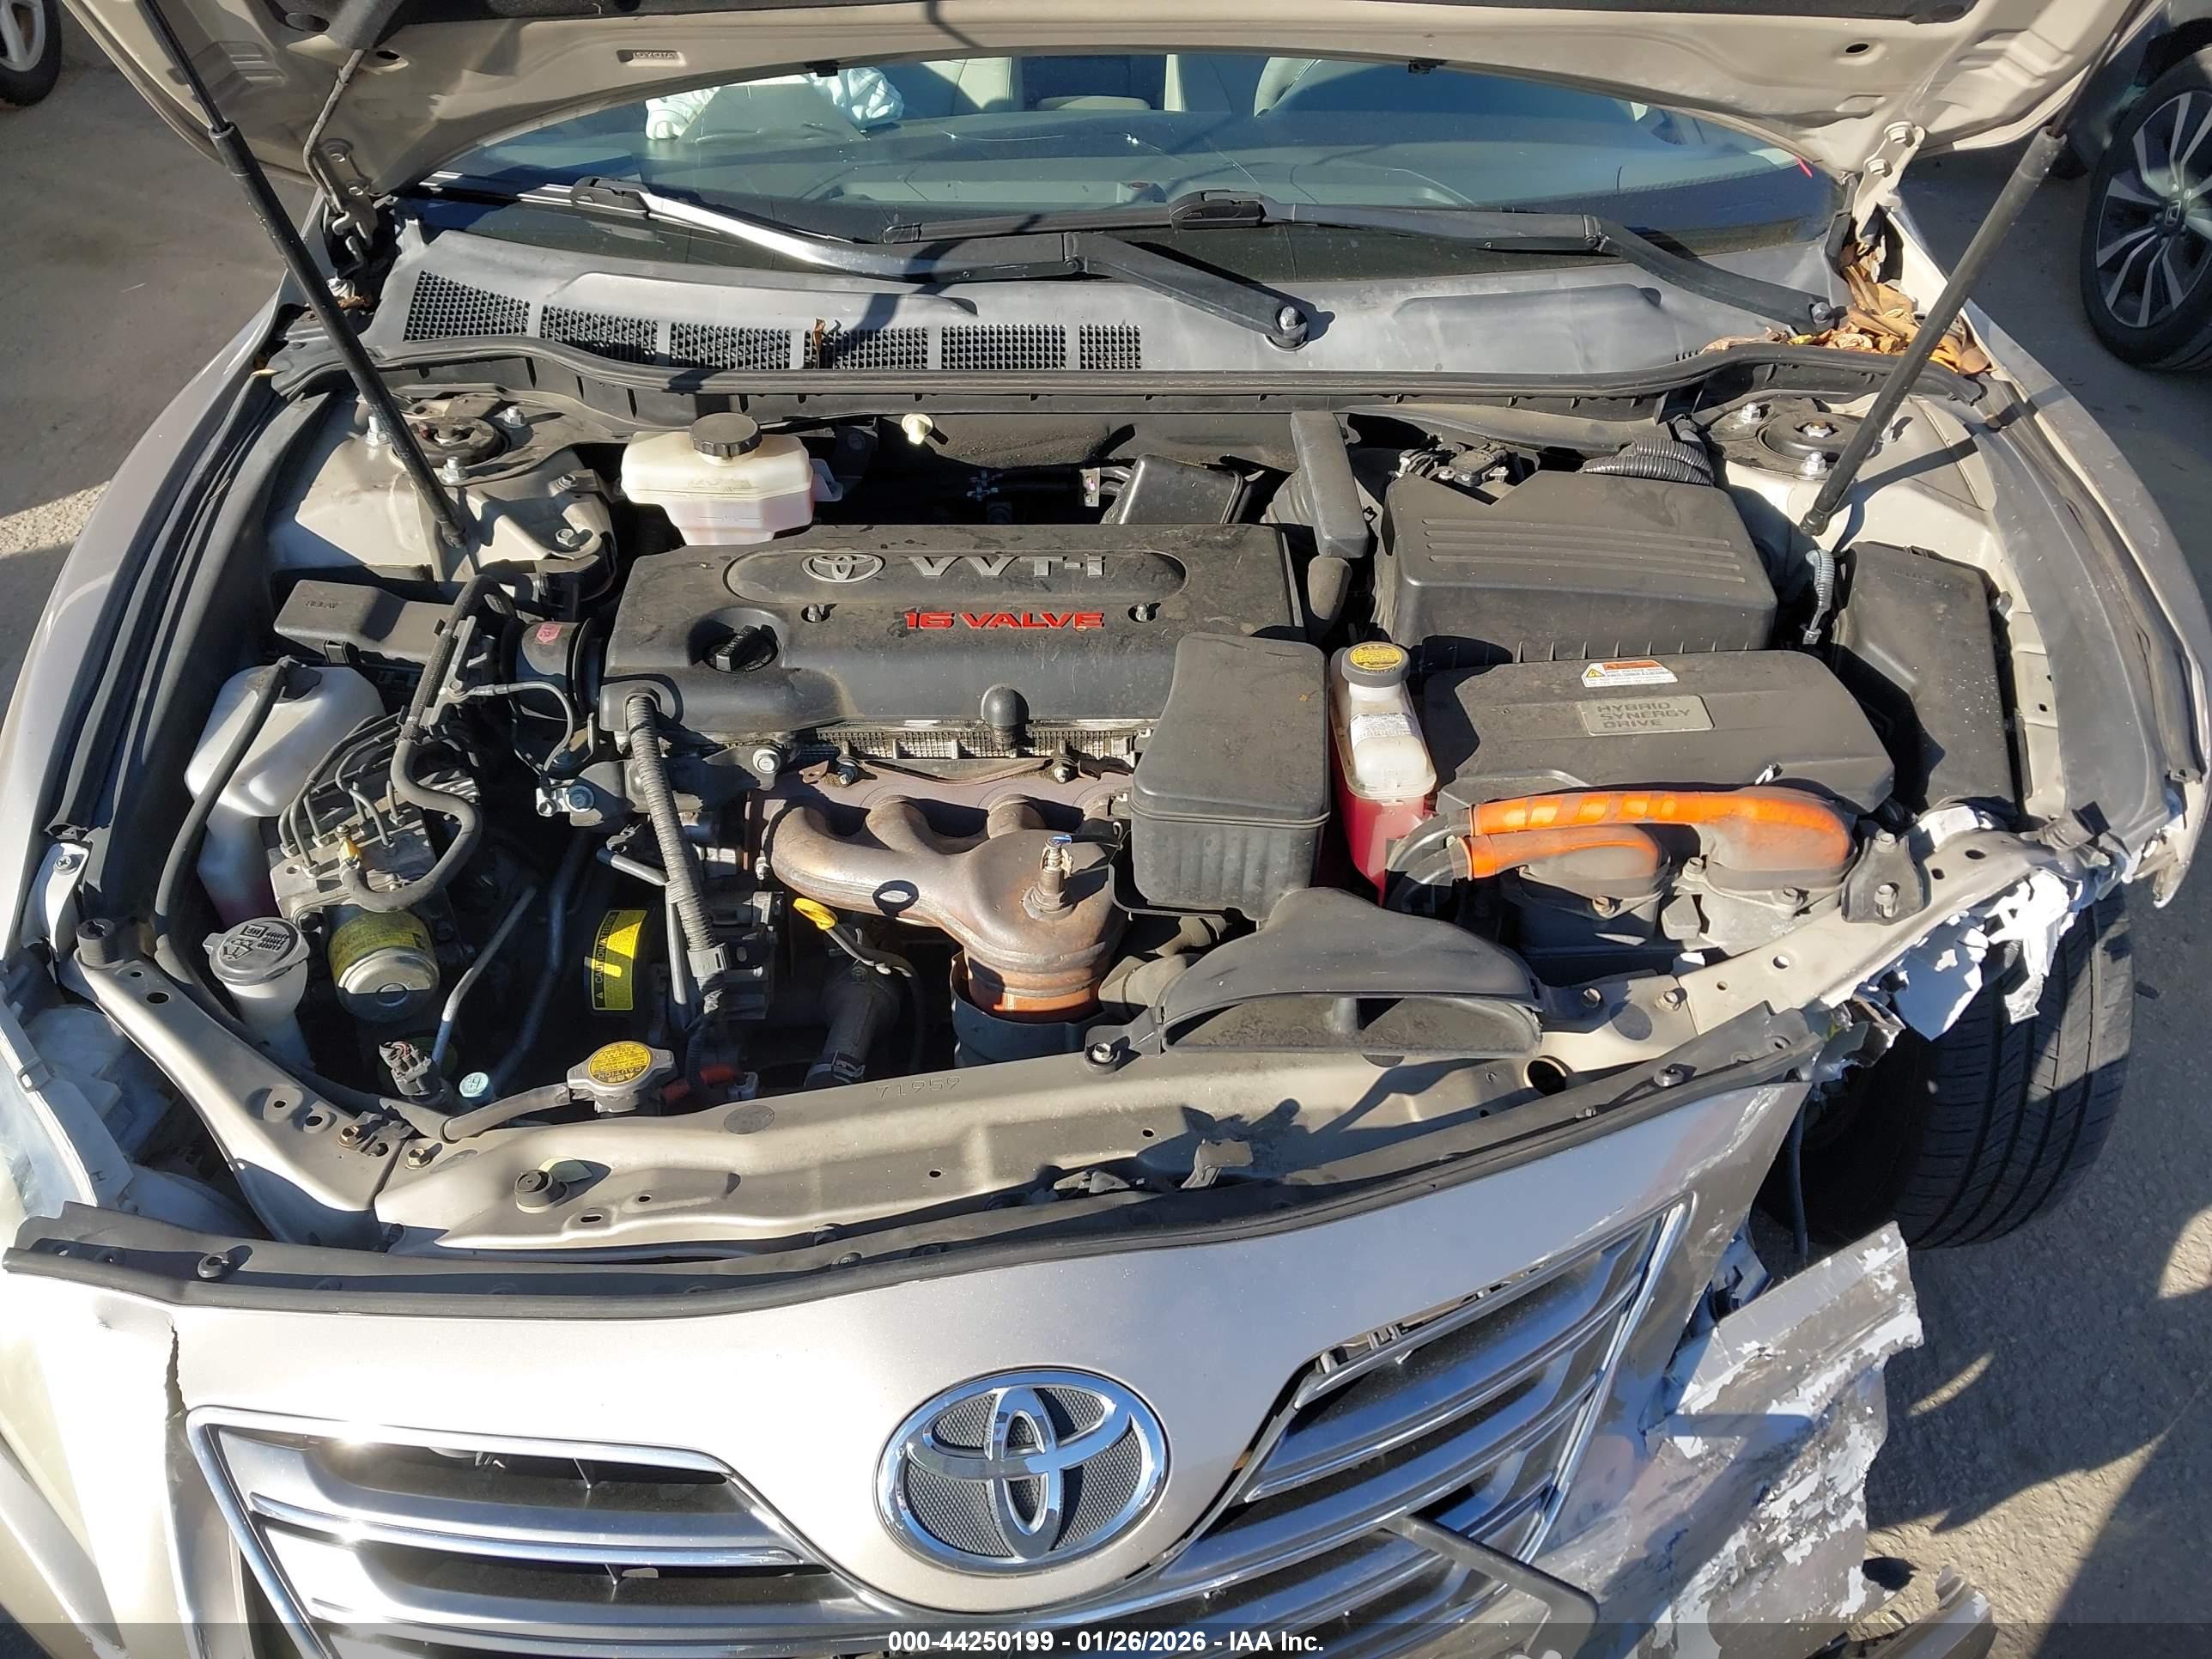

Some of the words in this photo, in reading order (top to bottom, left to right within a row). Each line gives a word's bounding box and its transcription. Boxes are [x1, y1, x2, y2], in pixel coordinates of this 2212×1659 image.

[906, 611, 955, 629] 16
[960, 611, 1104, 630] VALVE
[1597, 702, 1671, 714] HYBRID
[1600, 709, 1690, 721] SYNERGY
[1602, 719, 1662, 729] DRIVE
[597, 1066, 642, 1079] CAUTION
[875, 1075, 962, 1099] 71959
